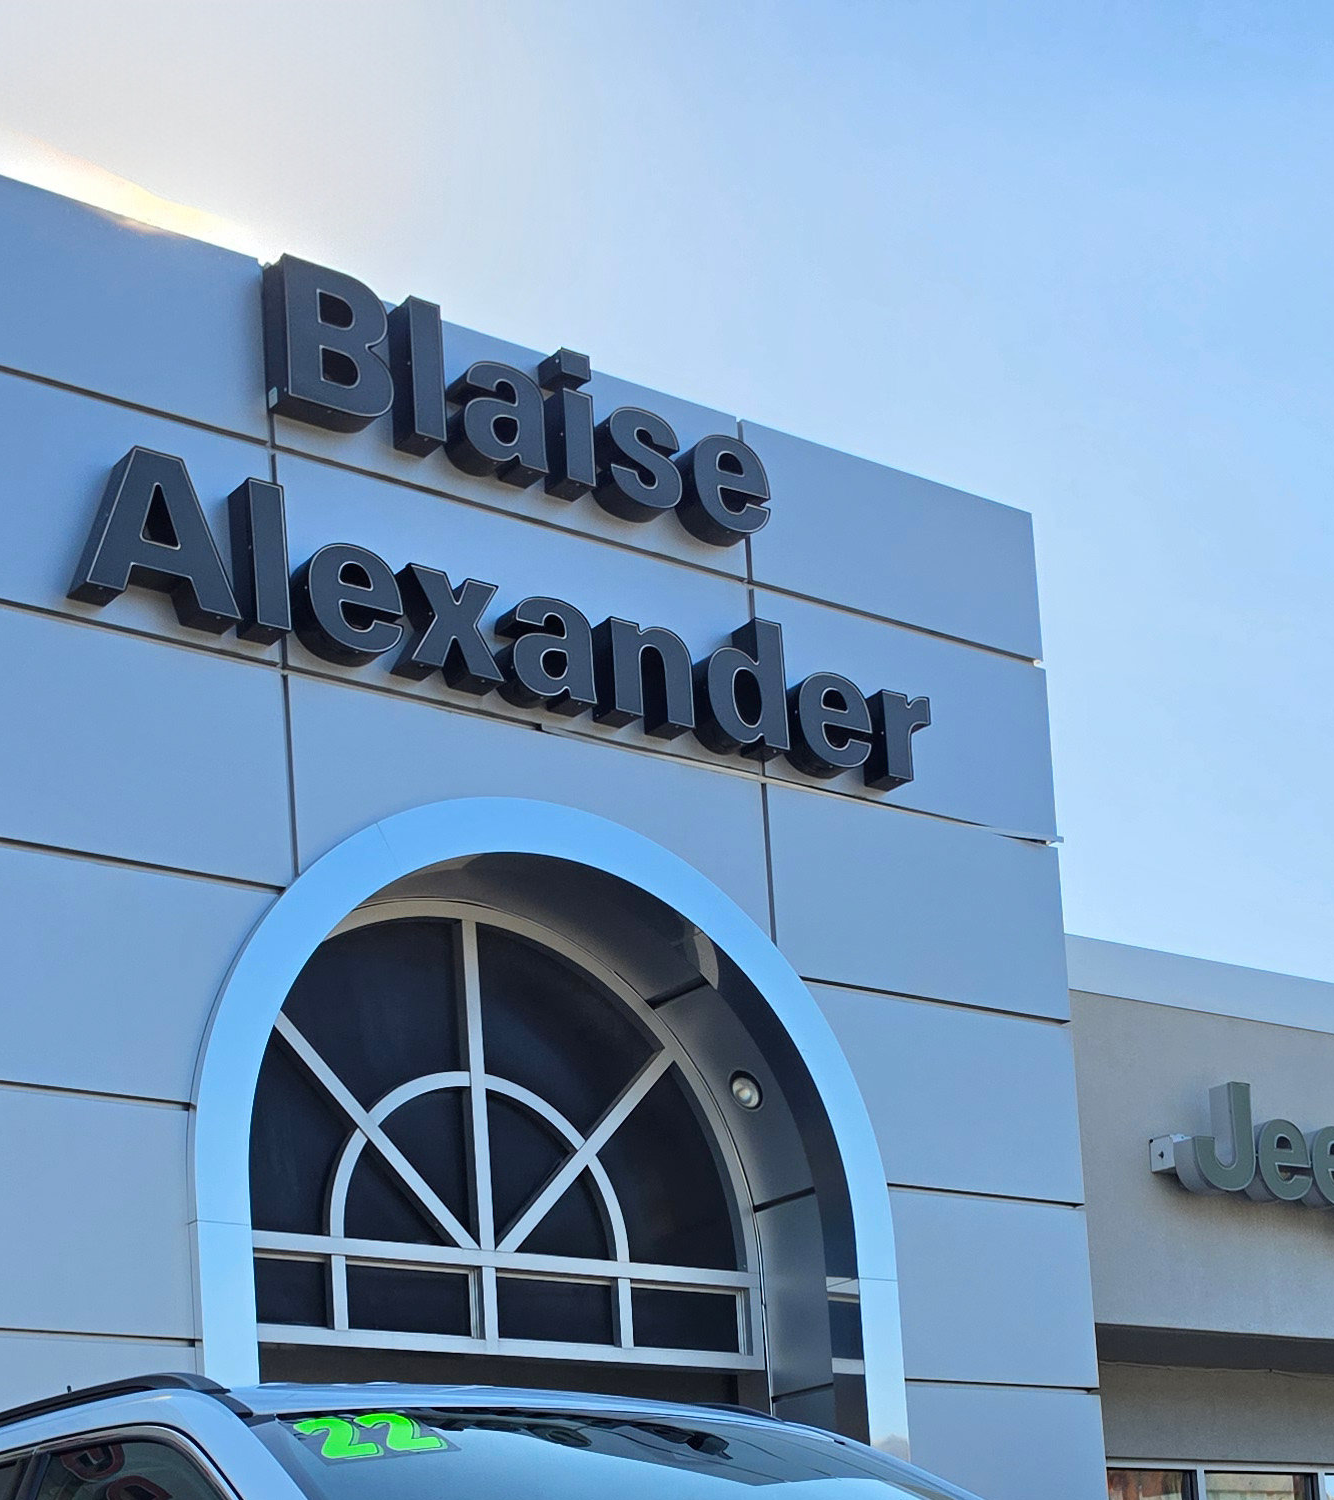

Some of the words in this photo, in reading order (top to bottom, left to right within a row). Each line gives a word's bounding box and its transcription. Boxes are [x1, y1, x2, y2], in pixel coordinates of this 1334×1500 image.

[264, 253, 771, 546] Blaise
[68, 446, 930, 791] Alexander
[293, 1413, 448, 1459] 22
